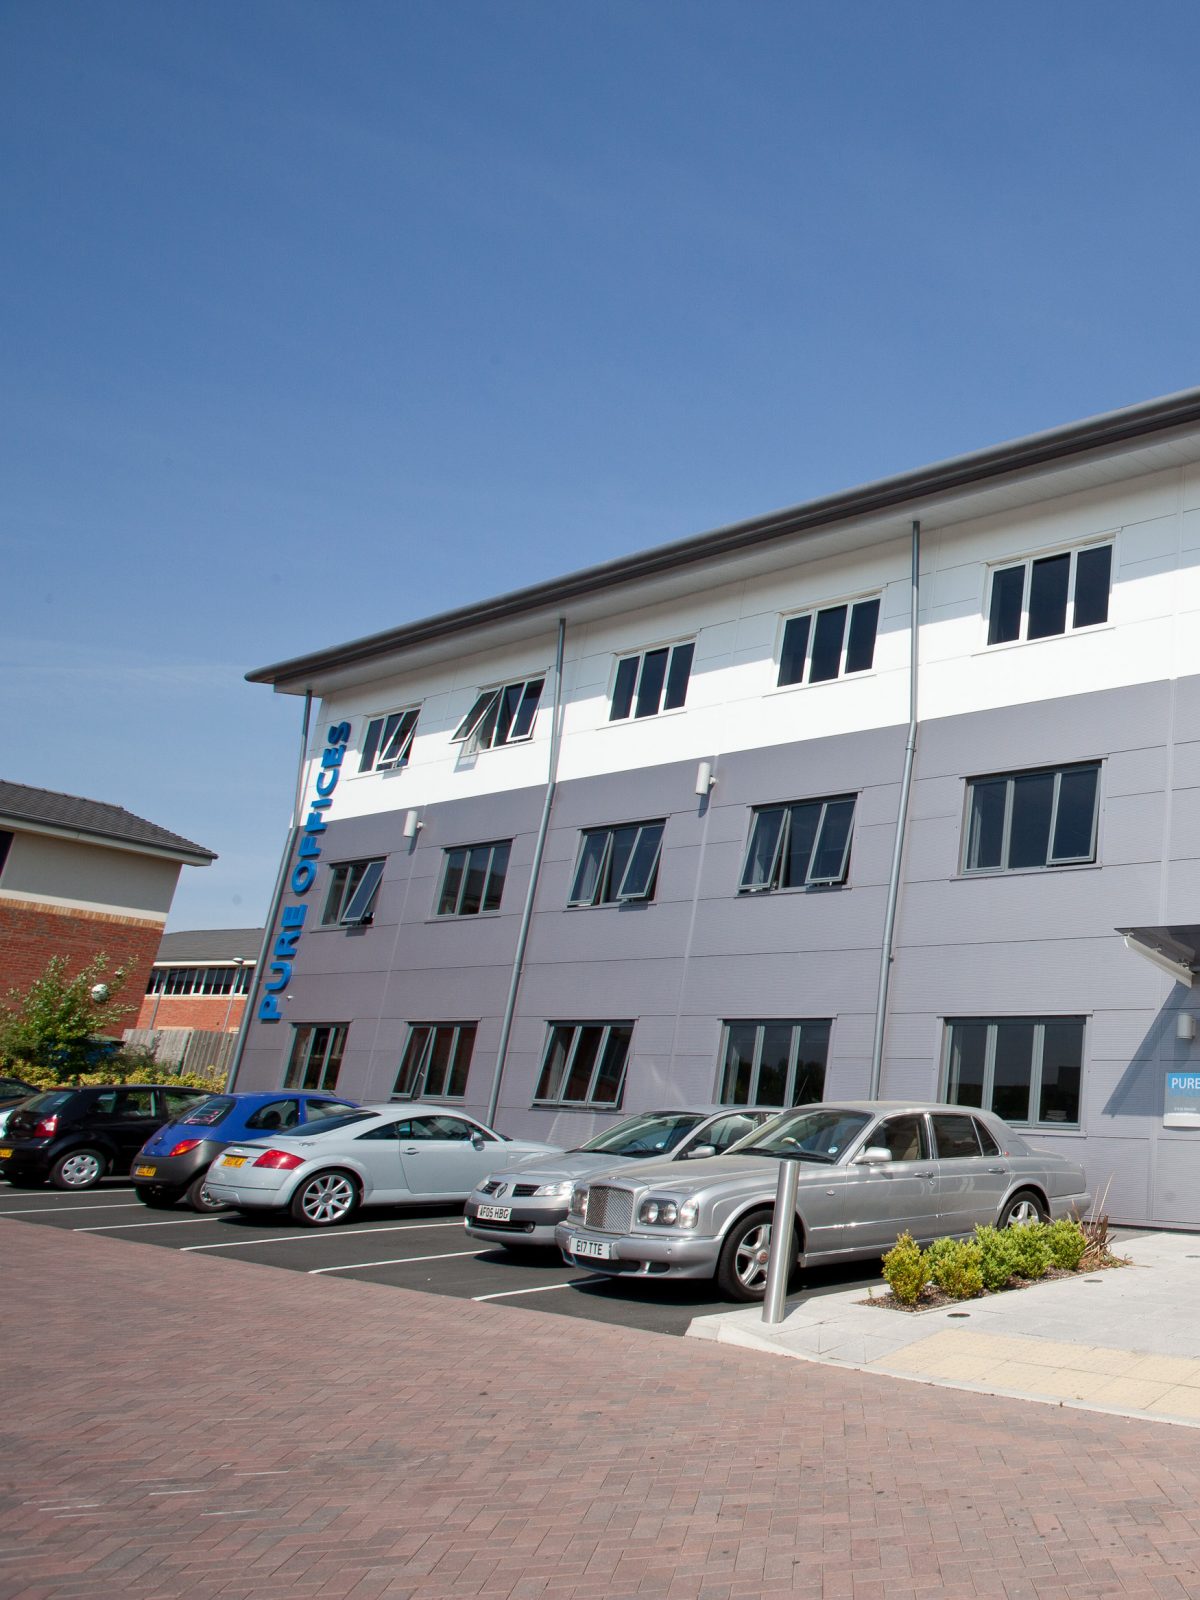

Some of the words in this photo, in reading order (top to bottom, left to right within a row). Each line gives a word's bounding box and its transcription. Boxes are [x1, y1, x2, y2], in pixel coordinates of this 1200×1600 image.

[258, 904, 307, 1021] PURE
[292, 721, 351, 894] OFFICES
[494, 1208, 509, 1219] HBG
[589, 1242, 603, 1256] TTE
